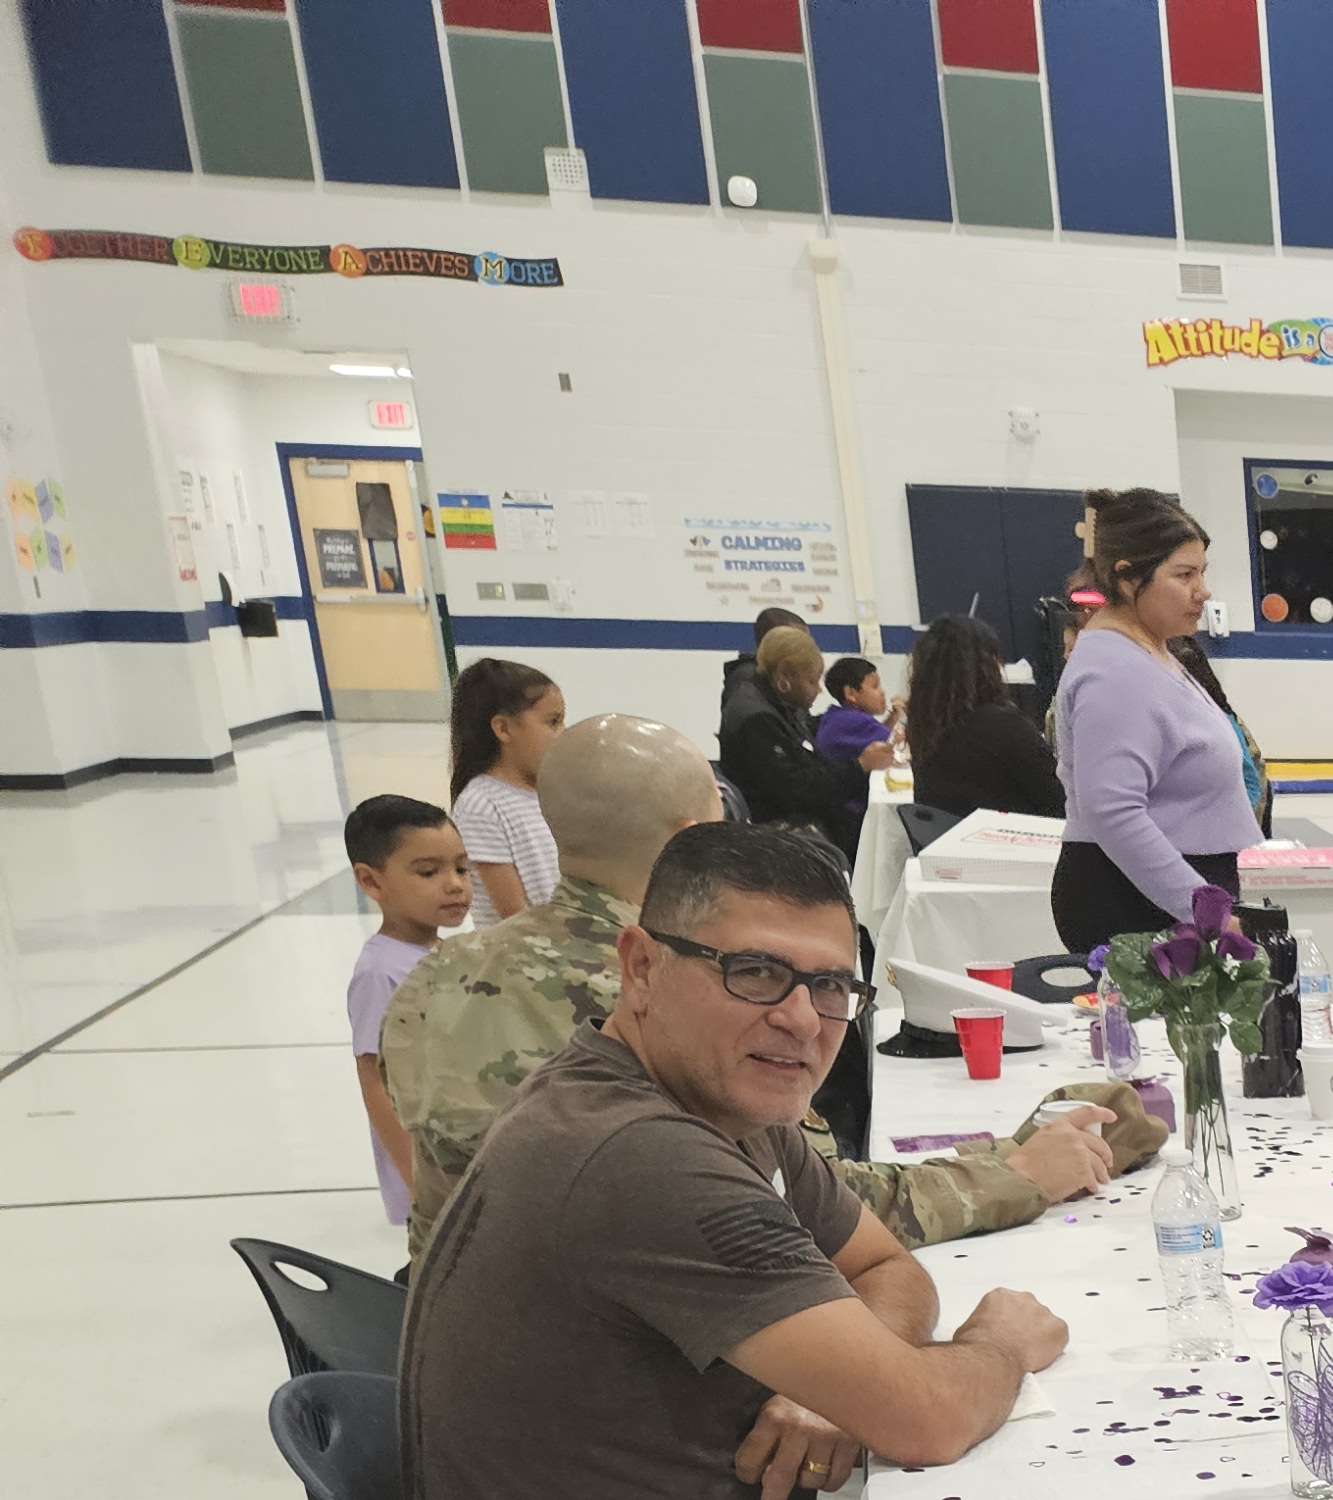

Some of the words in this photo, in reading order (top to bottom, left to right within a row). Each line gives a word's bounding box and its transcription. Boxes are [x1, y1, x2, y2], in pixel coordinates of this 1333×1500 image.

[184, 240, 325, 272] EVERYONE
[338, 248, 469, 277] ACHIEVES
[481, 257, 559, 285] MORE
[1144, 319, 1282, 367] Attitude
[1282, 326, 1300, 349] is
[377, 404, 405, 425] EXIT
[721, 535, 802, 551] CALMING
[724, 559, 806, 572] STRATEGIES
